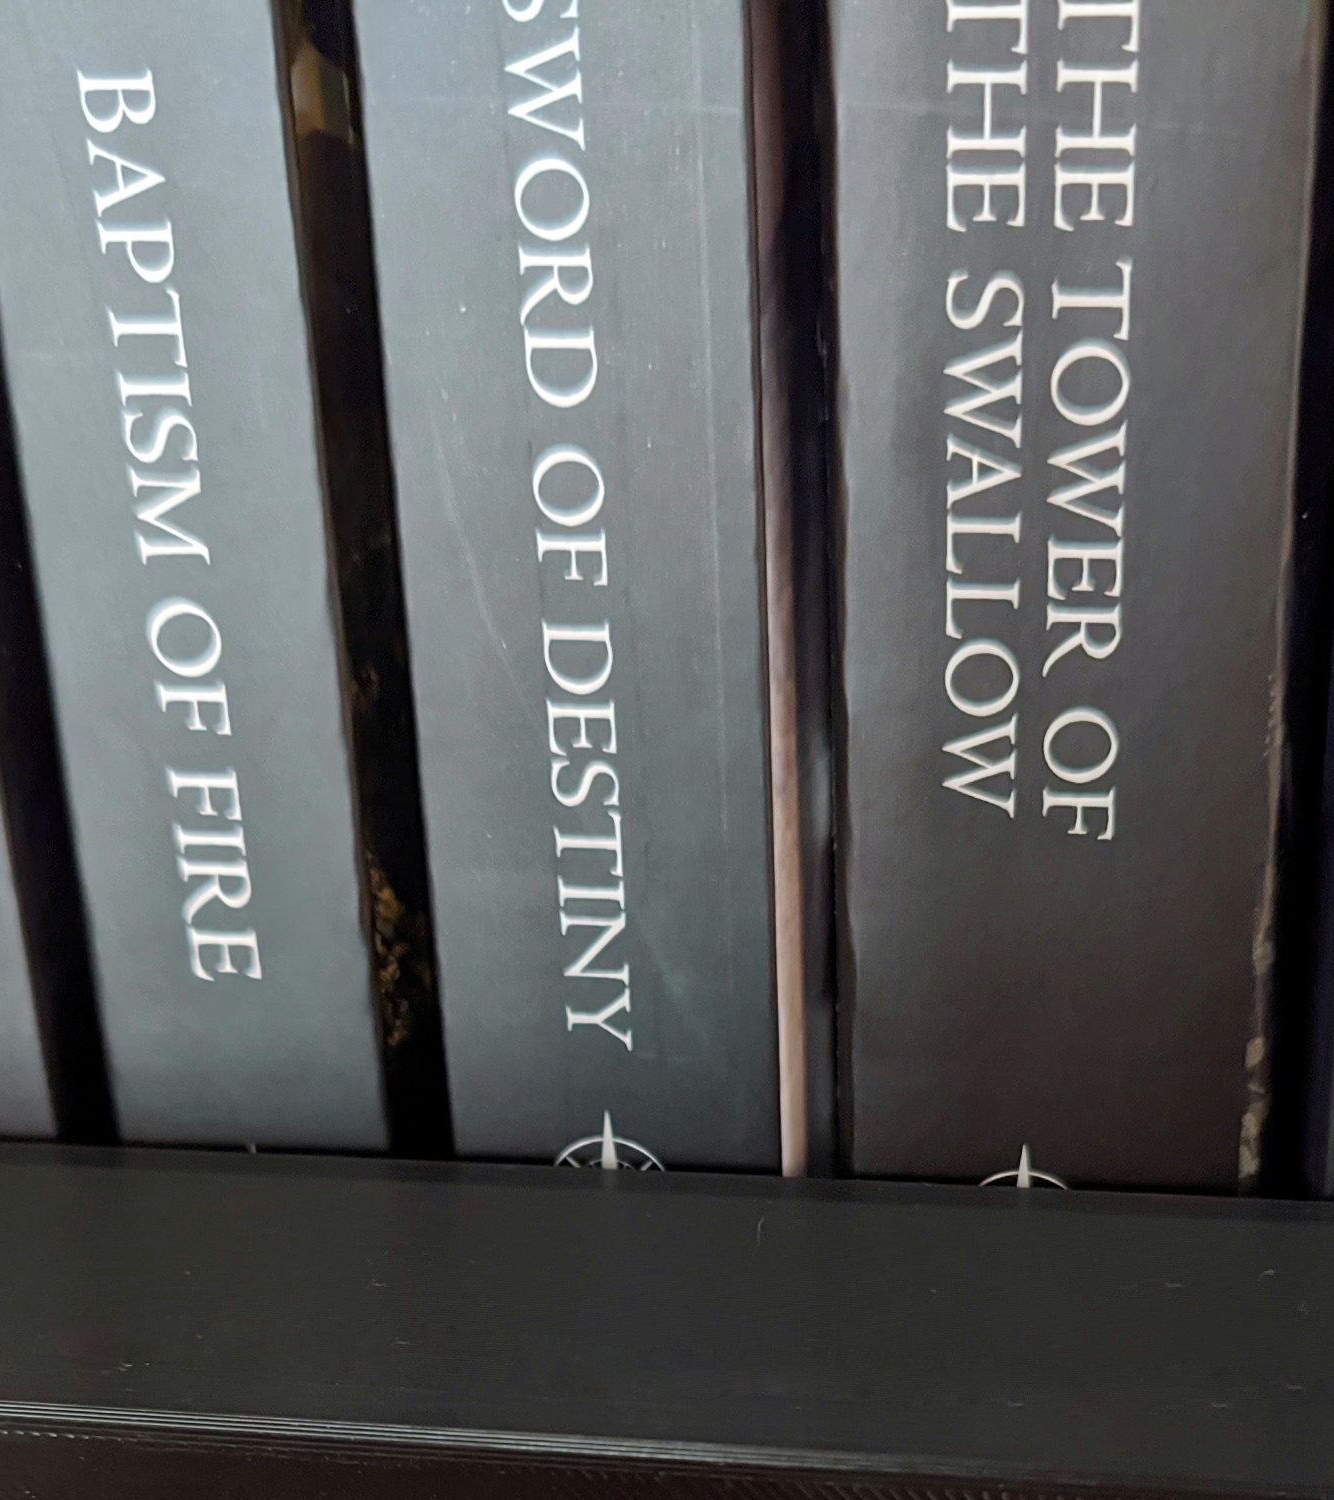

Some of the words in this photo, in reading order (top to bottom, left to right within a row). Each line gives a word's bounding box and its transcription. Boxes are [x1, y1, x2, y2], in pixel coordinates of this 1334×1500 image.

[946, 0, 1029, 232] THE
[1053, 0, 1141, 232] THE
[75, 64, 211, 566] BAPTISM
[531, 444, 610, 587] OF
[942, 268, 1026, 820] SWALLOW
[1043, 257, 1133, 679] TOWER
[145, 595, 233, 737] OF
[1042, 704, 1121, 842] OF
[165, 766, 263, 982] FIRE
[541, 618, 633, 1052] DESTINY
